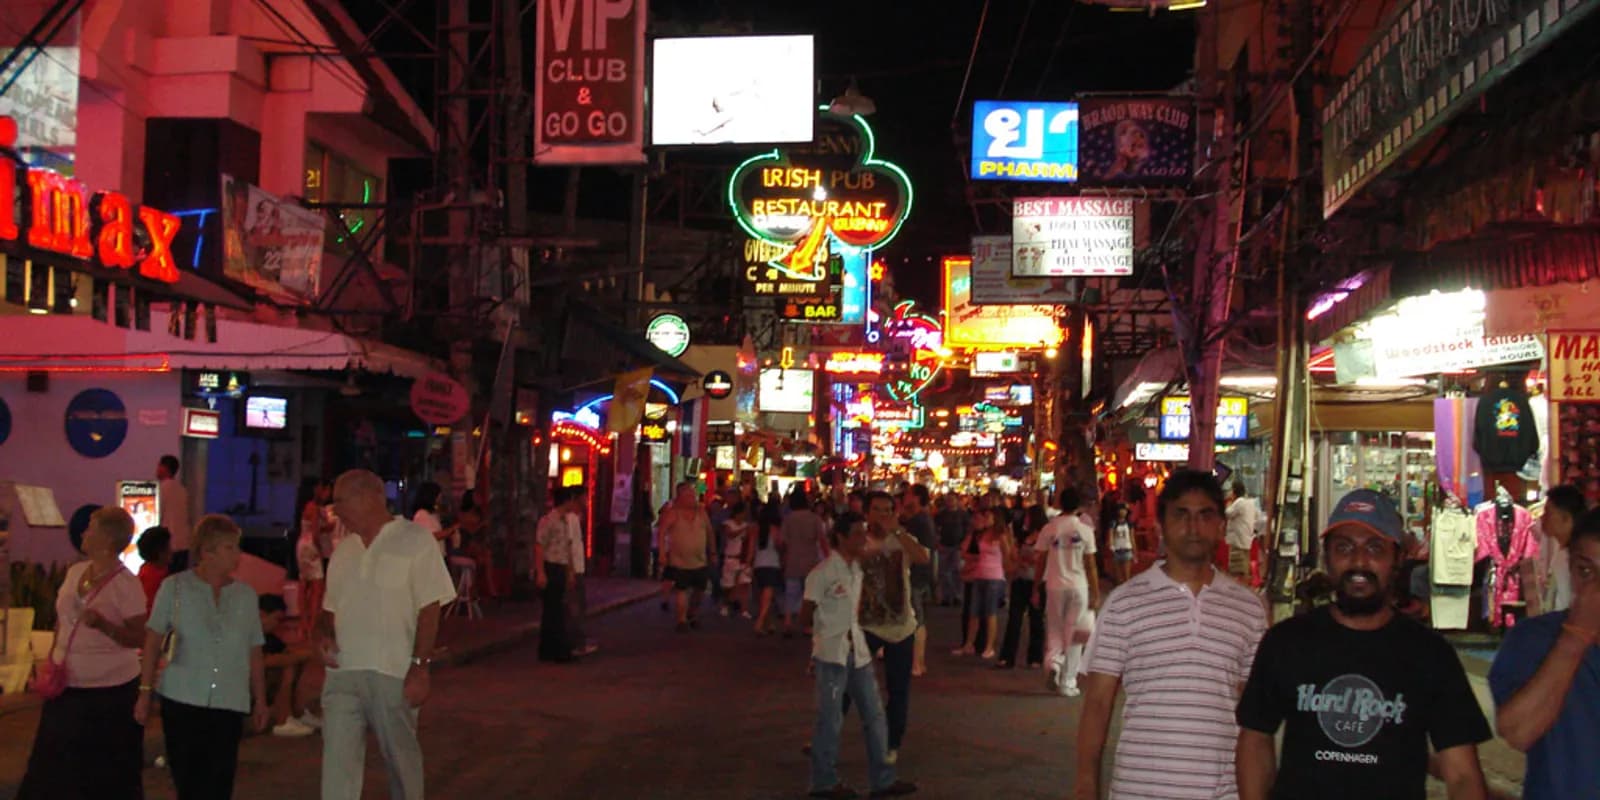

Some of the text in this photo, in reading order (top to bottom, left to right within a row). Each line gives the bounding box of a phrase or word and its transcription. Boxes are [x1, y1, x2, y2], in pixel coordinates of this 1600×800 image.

[551, 0, 633, 52] VIP
[547, 58, 627, 82] CLUB
[577, 87, 592, 104] &
[545, 109, 627, 136] GO GO
[1156, 104, 1191, 129] CLUB
[980, 160, 1077, 179] PHARM
[763, 168, 875, 189] IRISH PUB
[752, 198, 886, 217] RESTAURANT
[1013, 199, 1133, 215] BEST MASSAGE
[1083, 219, 1131, 231] MASSAGE
[1083, 236, 1131, 250] MASSAGE
[1083, 254, 1131, 267] MASSAGE
[755, 283, 817, 293] PER MINUTE
[804, 306, 837, 319] BAR
[1297, 683, 1407, 724] Hard Rock
[1335, 720, 1366, 734] CAFE
[1314, 750, 1378, 764] COPENHAGEN
